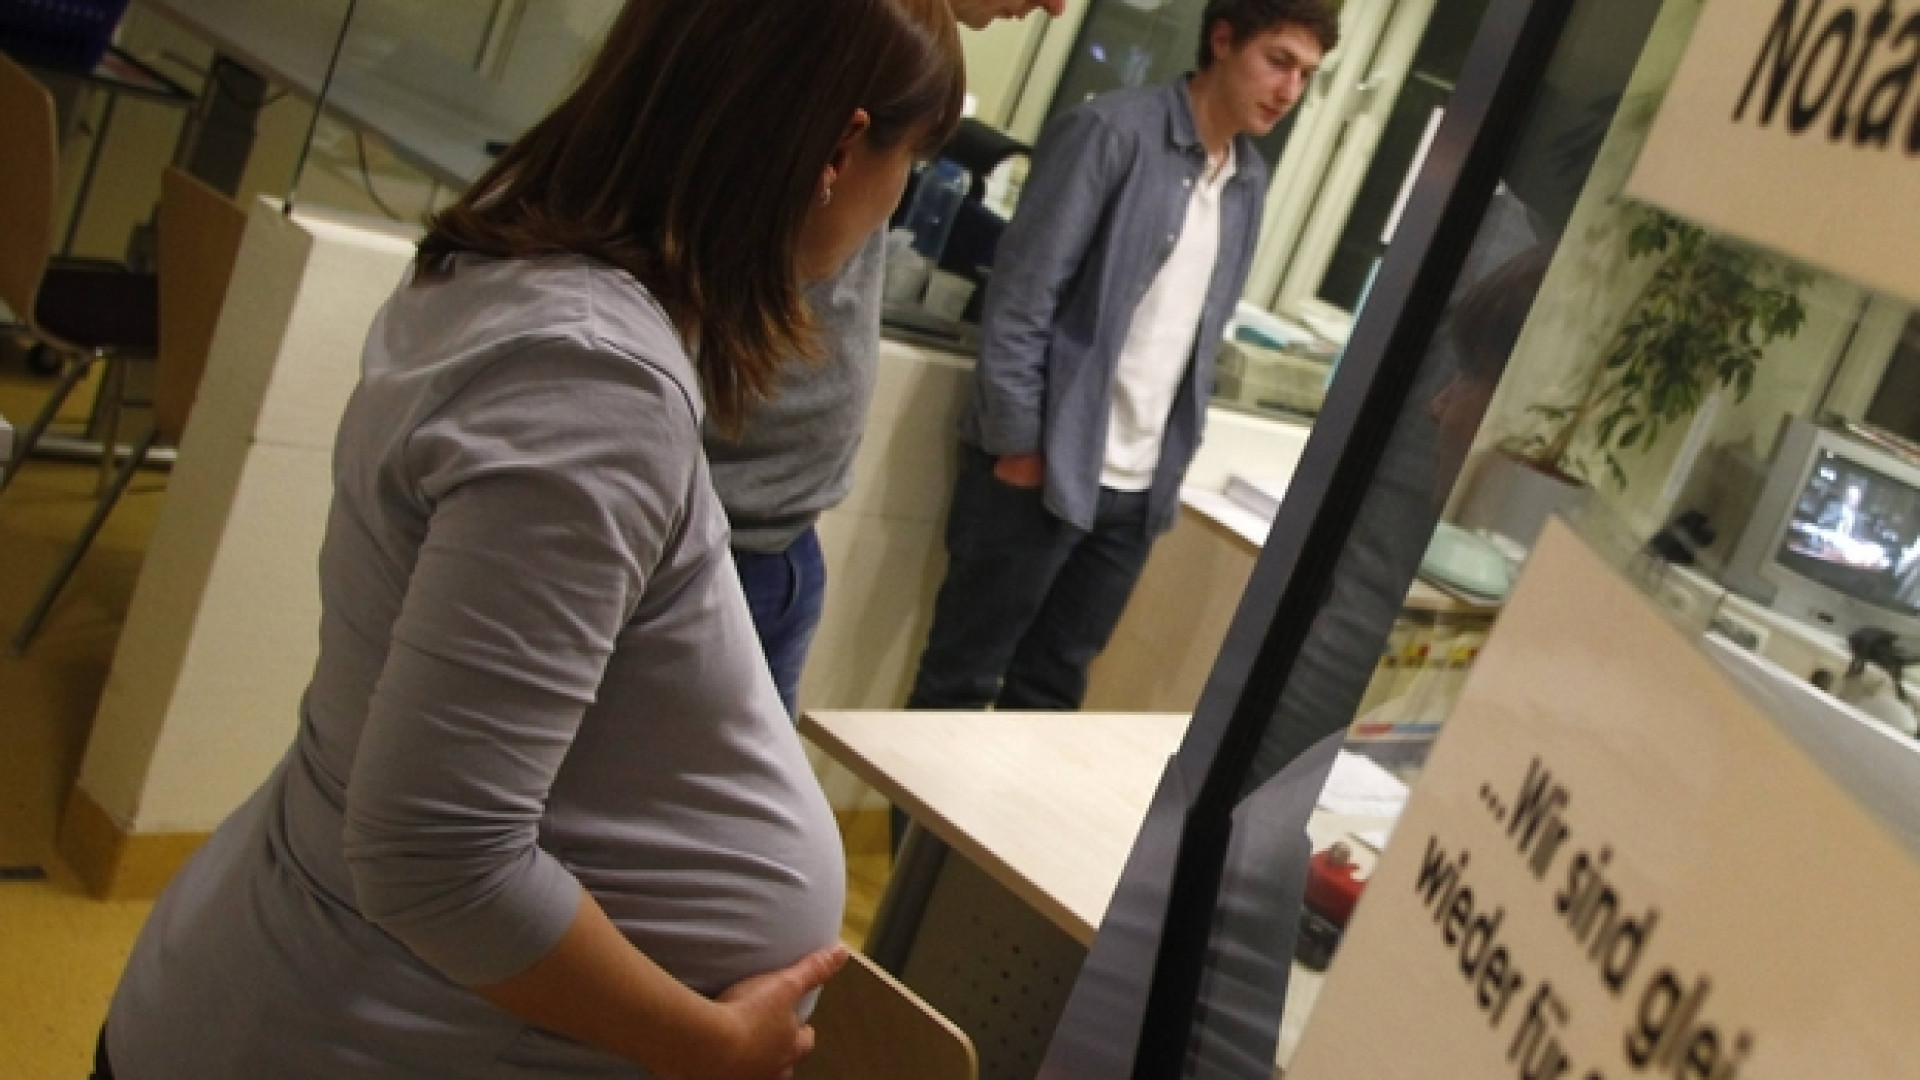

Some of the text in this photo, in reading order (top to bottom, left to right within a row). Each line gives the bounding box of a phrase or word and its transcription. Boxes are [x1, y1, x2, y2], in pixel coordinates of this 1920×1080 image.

[1731, 0, 1920, 156] Nota
[1415, 834, 1525, 1030] wieder
[1555, 842, 1660, 997] sind
